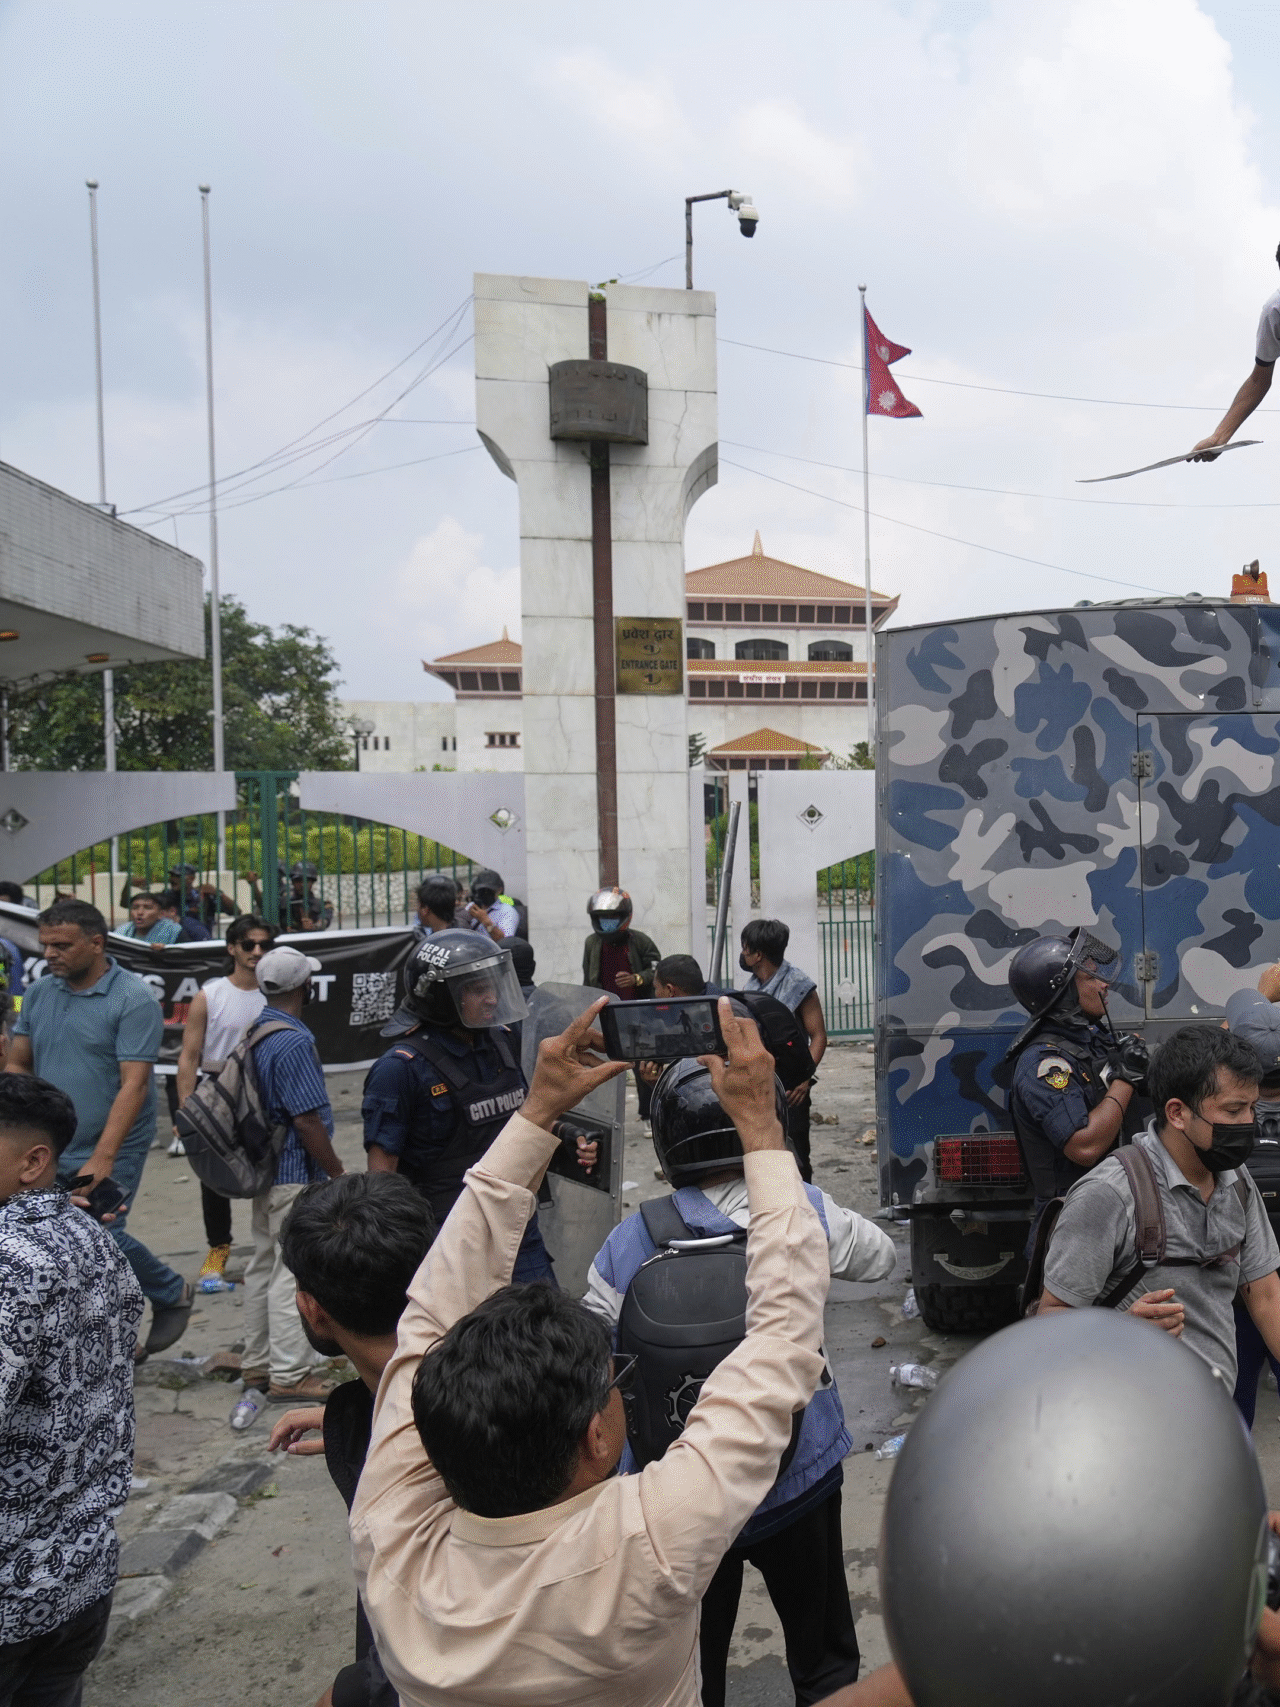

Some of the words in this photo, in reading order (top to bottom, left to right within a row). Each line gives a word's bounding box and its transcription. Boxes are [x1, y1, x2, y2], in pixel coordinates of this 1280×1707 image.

[622, 627, 649, 640] प्रवेश
[621, 660, 658, 670] ENTRANCE
[660, 660, 678, 670] GATE
[416, 950, 448, 968] POLICE
[421, 942, 451, 960] NEPAL
[469, 1098, 496, 1121] CITY
